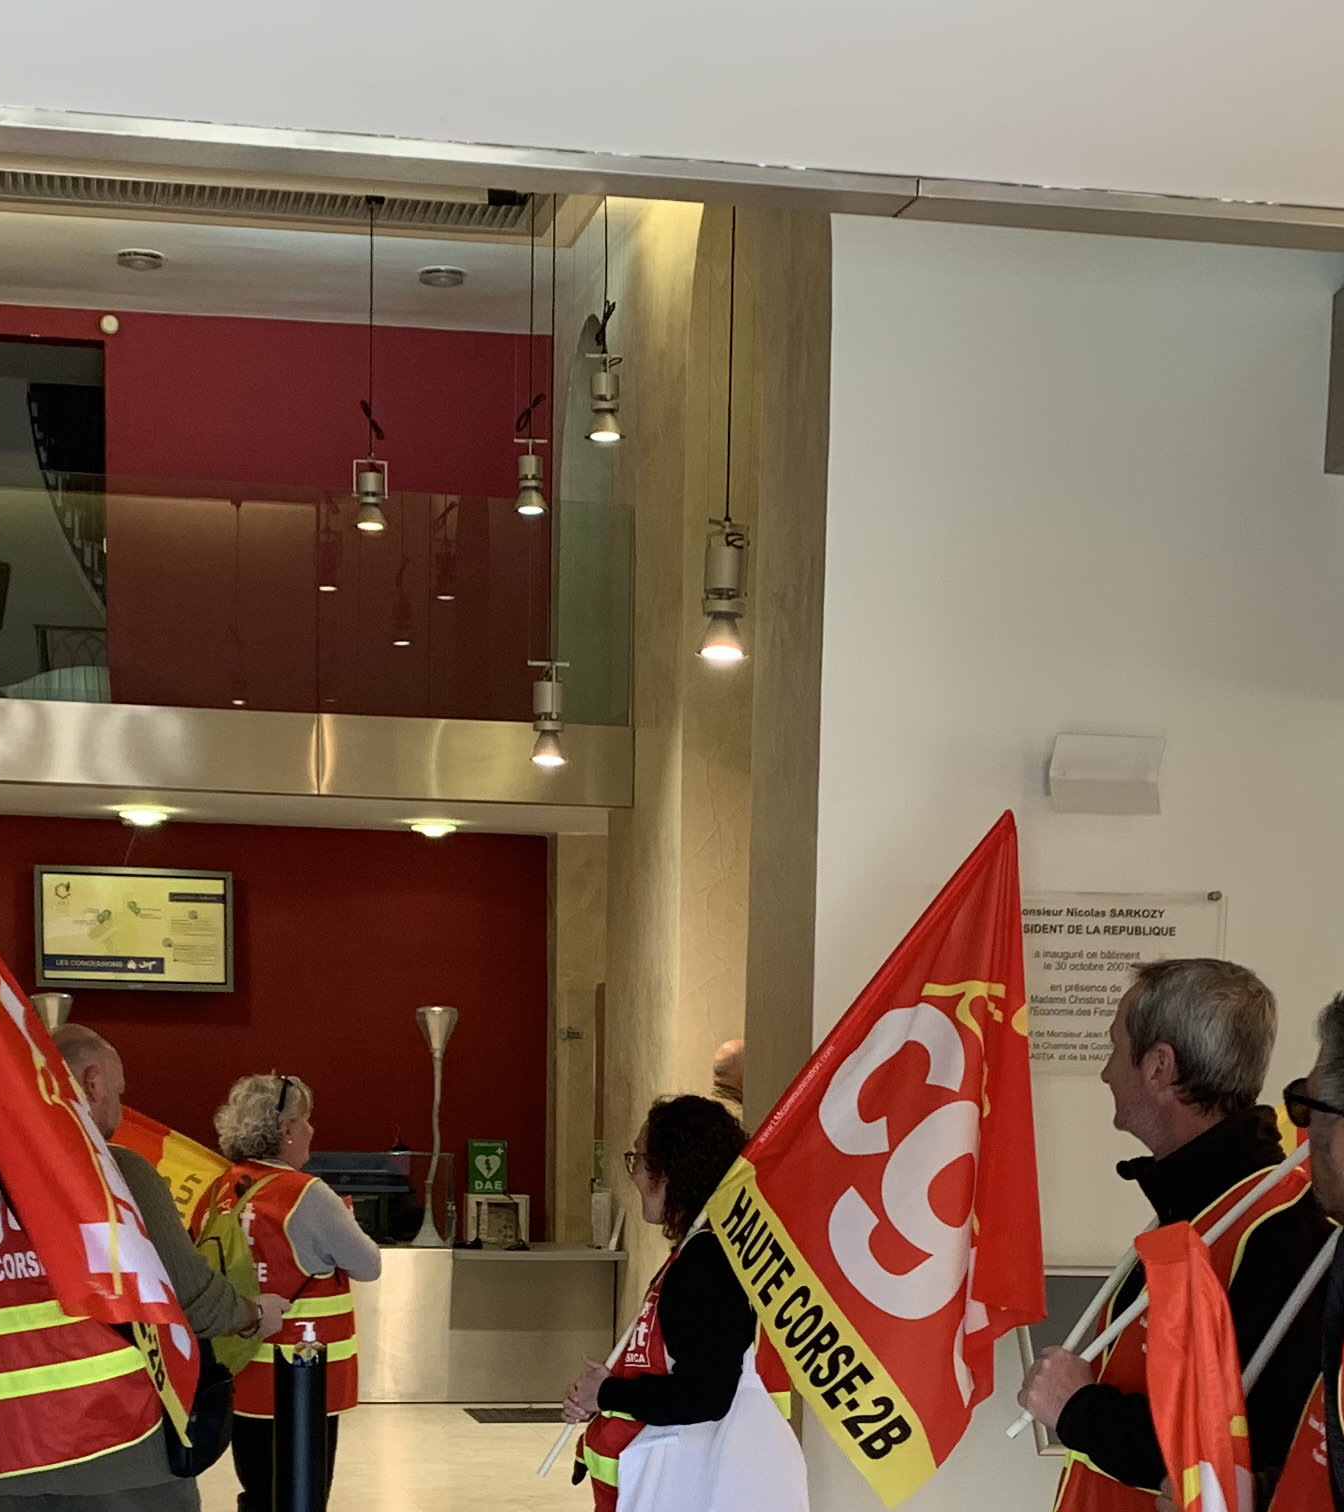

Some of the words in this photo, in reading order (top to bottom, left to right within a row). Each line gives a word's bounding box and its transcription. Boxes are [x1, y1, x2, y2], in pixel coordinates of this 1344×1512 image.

[1021, 907, 1063, 917] onsieur
[1066, 907, 1106, 918] Nicolas
[1109, 908, 1166, 919] SARKOZY
[1023, 924, 1064, 934] SIDENT
[1067, 924, 1083, 934] DE
[1086, 925, 1101, 935] LA
[1103, 925, 1177, 936] REPUBLIQUE
[1043, 950, 1084, 960] inauguré
[1086, 952, 1097, 960] ce
[1100, 950, 1141, 960] bâtiment
[1043, 962, 1052, 970] le
[1055, 962, 1067, 971] 30
[1069, 962, 1104, 971] octobre
[1106, 962, 1129, 972] 2007
[1050, 984, 1062, 992] en
[1064, 984, 1107, 993] présence
[1109, 984, 1122, 993] de
[1068, 995, 1105, 1004] Christine
[1030, 1052, 1055, 1060] ASTIA
[818, 1002, 982, 1320] cg
[474, 1180, 503, 1190] DAE
[720, 1185, 796, 1308] HAUTE
[774, 1285, 913, 1460] CORSE-2B
[624, 1352, 646, 1363] SICA
